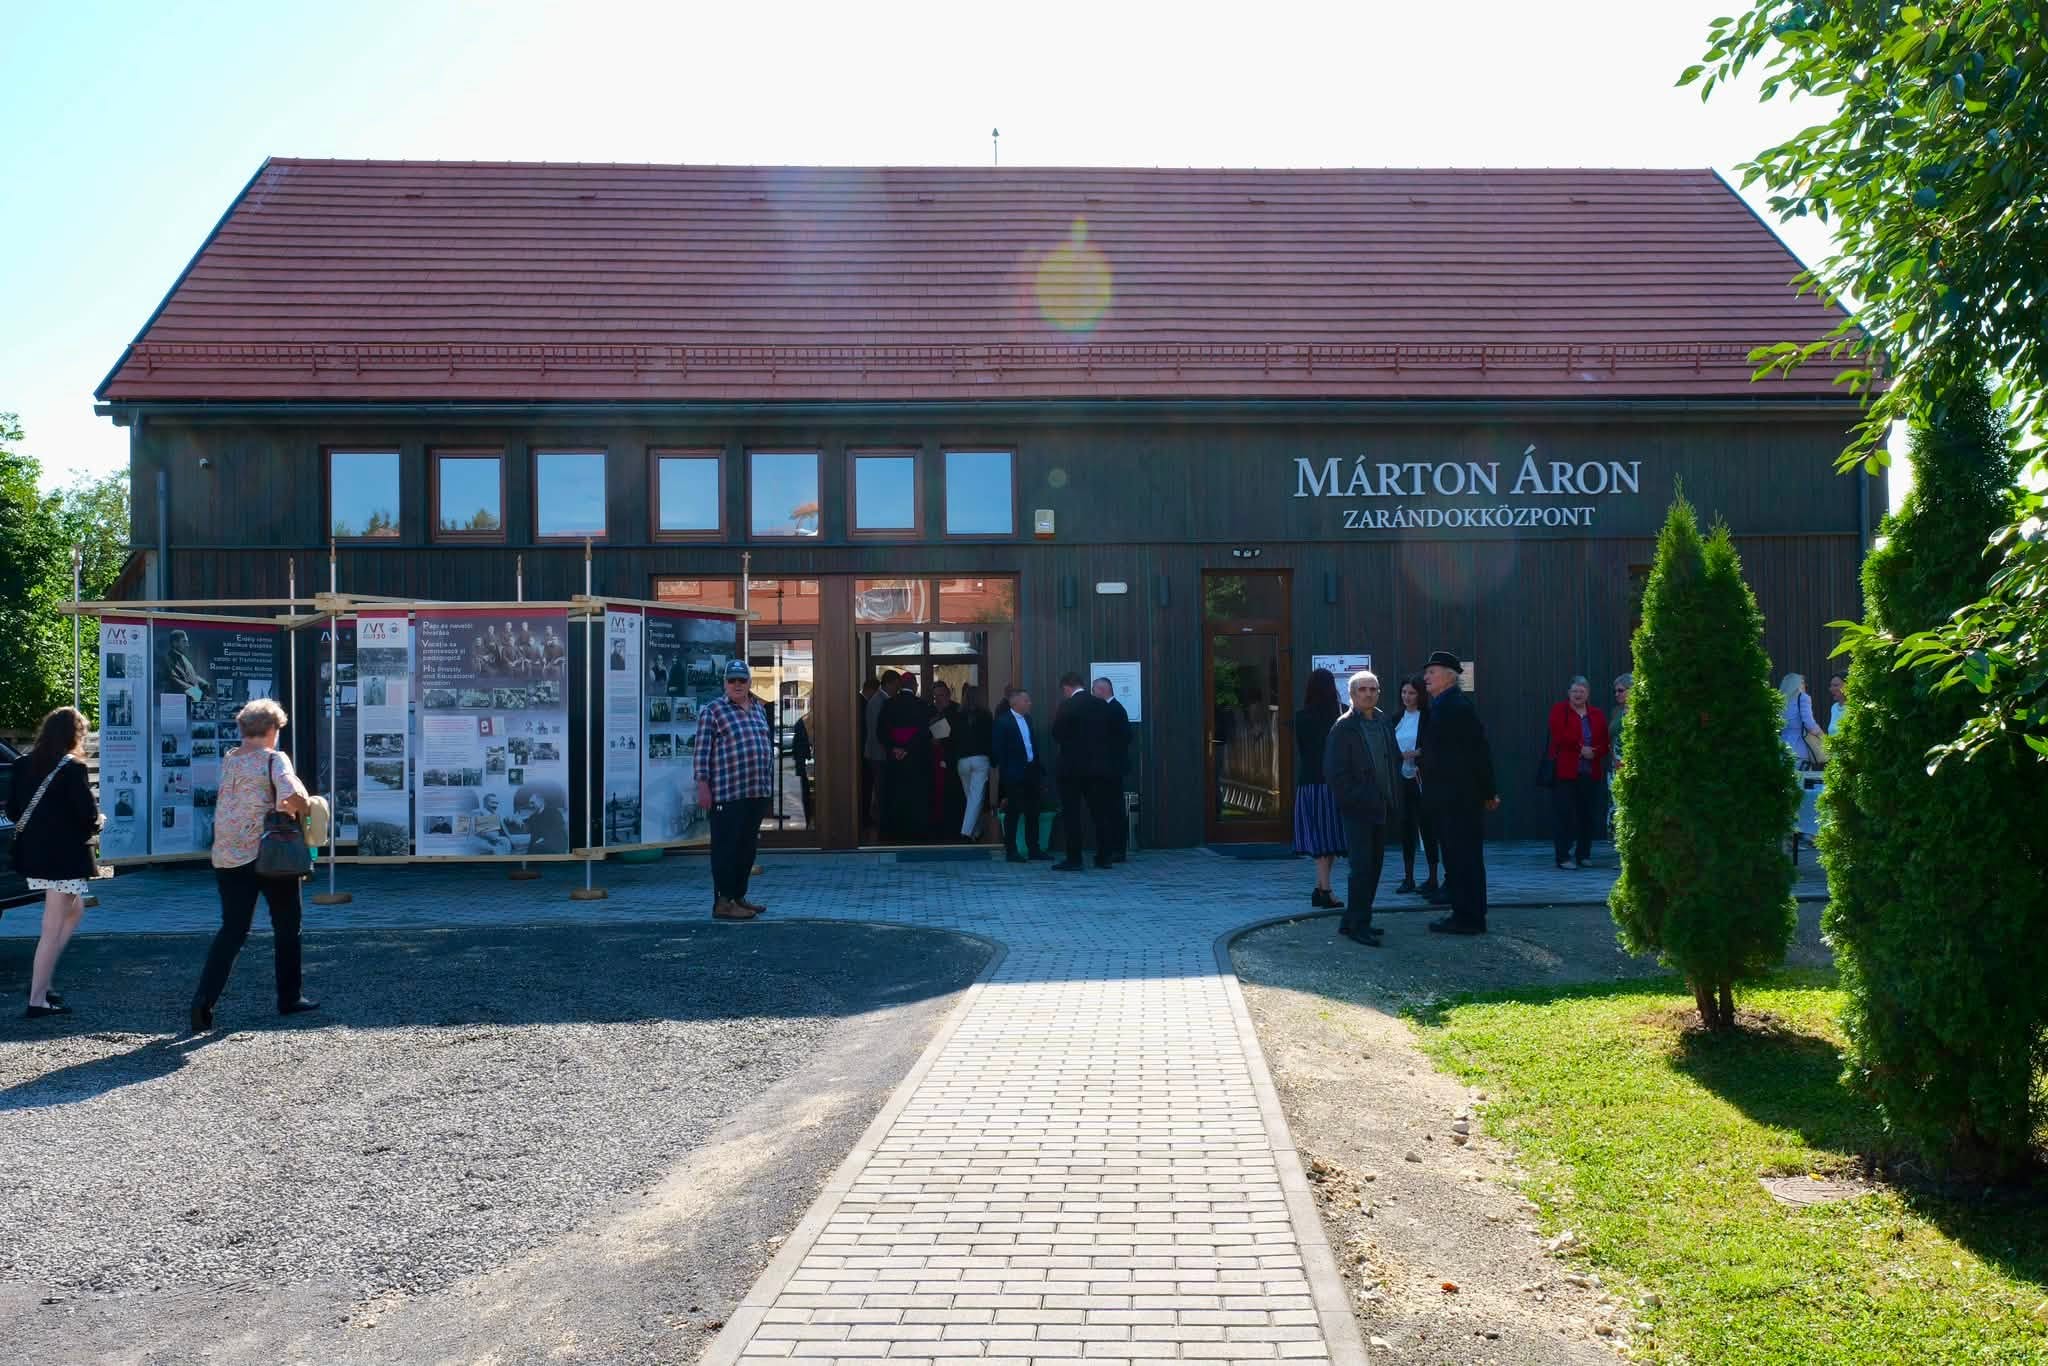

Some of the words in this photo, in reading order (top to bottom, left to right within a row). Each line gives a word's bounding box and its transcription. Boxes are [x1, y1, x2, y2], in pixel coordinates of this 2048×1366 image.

[1293, 454, 1501, 497] MÁRTON
[1509, 443, 1642, 495] ÁRON
[1343, 504, 1596, 529] ZARÁNDOKKÖZPONT
